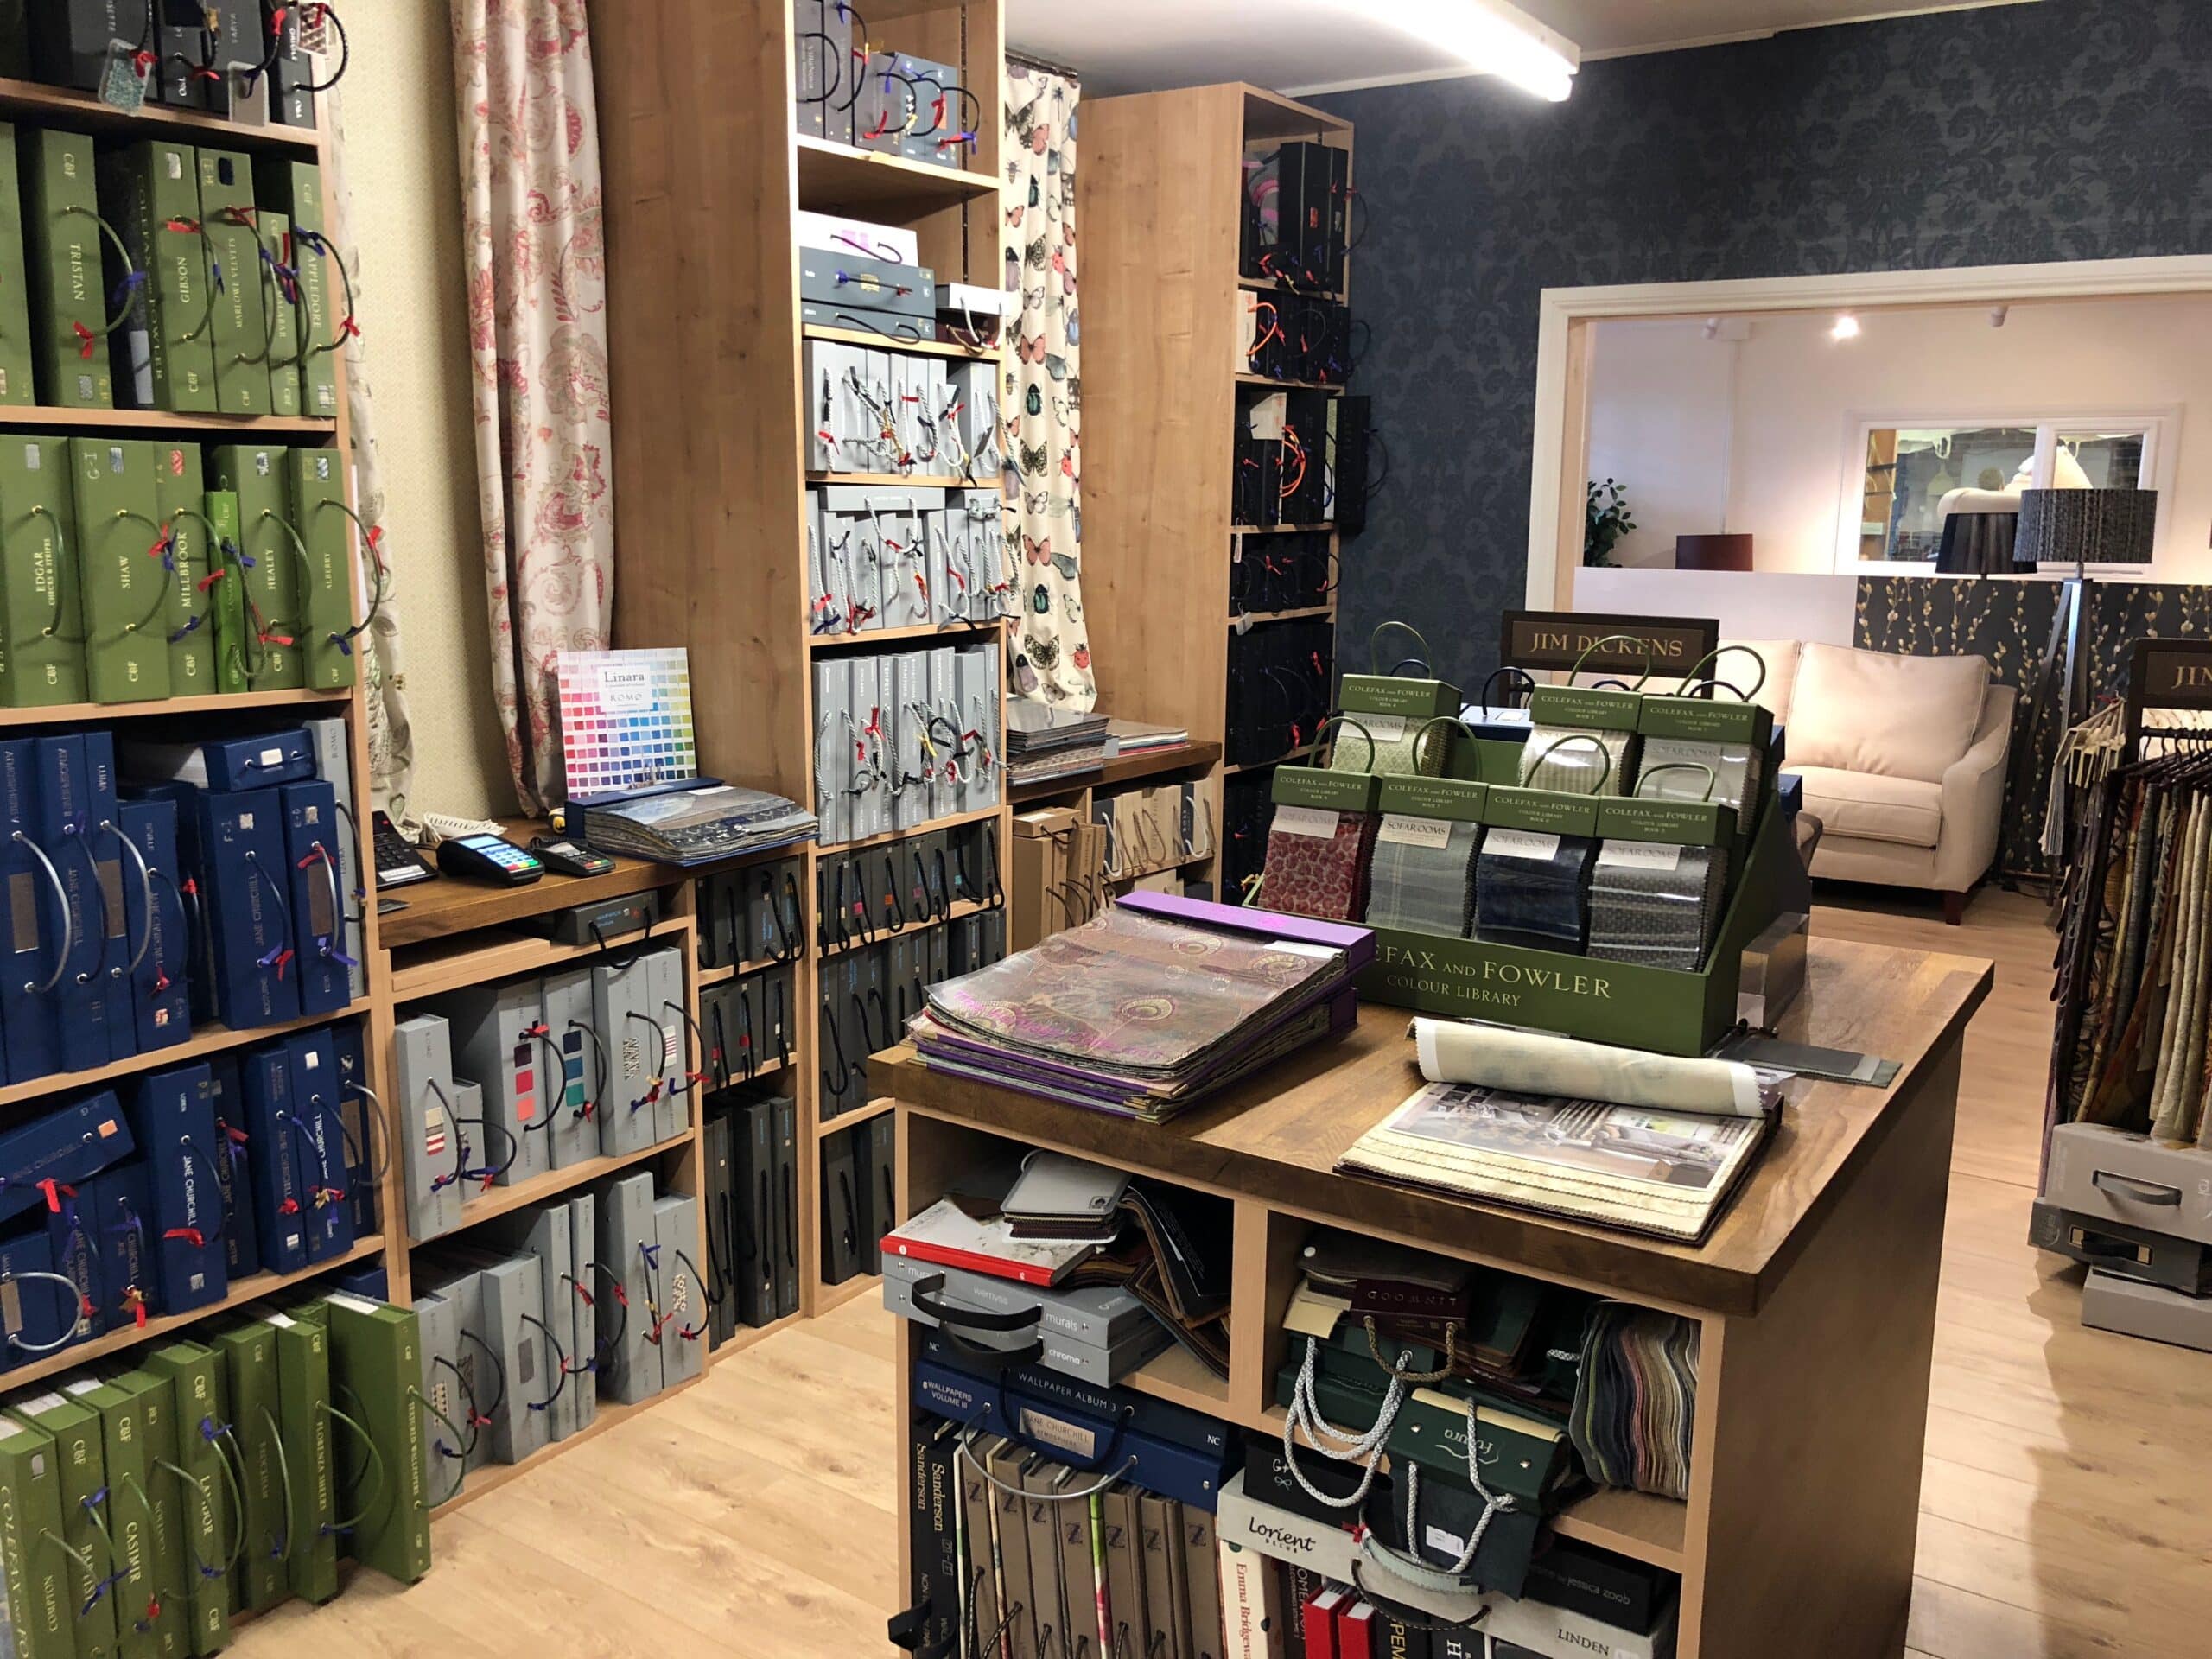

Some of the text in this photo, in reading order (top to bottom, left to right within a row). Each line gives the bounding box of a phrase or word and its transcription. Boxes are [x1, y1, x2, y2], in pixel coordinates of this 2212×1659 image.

[69, 242, 86, 302] TRISTAN
[137, 173, 163, 381] COLEFAX FOWLER
[179, 256, 190, 304] GIBSON
[228, 238, 244, 328] MARLOWE VELVETS
[308, 255, 323, 330] APPLEDORE
[43, 537, 53, 567] STRIPES
[176, 531, 192, 608] MILLBROOK
[268, 548, 277, 591] HEALEY
[35, 550, 47, 594] EDGAR
[122, 555, 131, 590] SHAW
[324, 551, 333, 590] ALBERRY
[48, 575, 56, 607] CHECKS
[1529, 632, 1684, 658] JIM DICKENS
[604, 671, 645, 683] Linara
[1349, 685, 1431, 698] COLEFAX FOWLER
[610, 693, 643, 702] ROMO
[1541, 696, 1634, 709] COLEFAX FOWLER
[1649, 707, 1749, 721] COLEFAX FOWLER
[1280, 777, 1363, 790] COLEFAX FOWLER
[1389, 784, 1478, 798] COLEFAX FOWLER
[1494, 796, 1591, 814] COLEFAX FOWLER
[1605, 807, 1708, 822] COLEFAX FOWLER
[1387, 821, 1446, 836] SOFAROOMS
[69, 868, 84, 947] JANE CHURCHILL
[247, 872, 264, 946] JANE CHURCHILL
[1386, 975, 1522, 1007] COLOUR LIBRARY
[1443, 963, 1476, 976] AND
[1483, 961, 1611, 999] FOWLER
[315, 1112, 328, 1159] CHURCHILL
[182, 1155, 197, 1227] JANE CHURCHILL
[78, 1252, 91, 1299] CHURCHIL
[129, 1233, 140, 1282] CHURCHILL
[907, 1265, 934, 1280] mural
[1045, 1312, 1079, 1332] murals
[928, 1341, 941, 1352] NC
[1047, 1347, 1081, 1365] chroma
[927, 1380, 973, 1402] WALLPAPERS
[931, 1391, 961, 1408] VOLUME
[1018, 1371, 1117, 1413] WALLPAPER ALBUM 3
[1046, 1419, 1089, 1444] CHURCHILL
[1206, 1434, 1221, 1446] NC
[1444, 1428, 1494, 1454] Fuuro
[410, 1445, 422, 1497] WALLPAPERS
[917, 1442, 927, 1510] Sanderson
[200, 1475, 214, 1536] LADOR
[932, 1462, 946, 1532] Sanderson
[1, 1485, 22, 1592] COLEFAX
[1249, 1516, 1316, 1552] Lorient
[125, 1521, 141, 1584] CASIMIR
[1236, 1562, 1248, 1602] Emma
[42, 1574, 58, 1632] COMPTON
[1557, 1628, 1611, 1656] LINDEN
